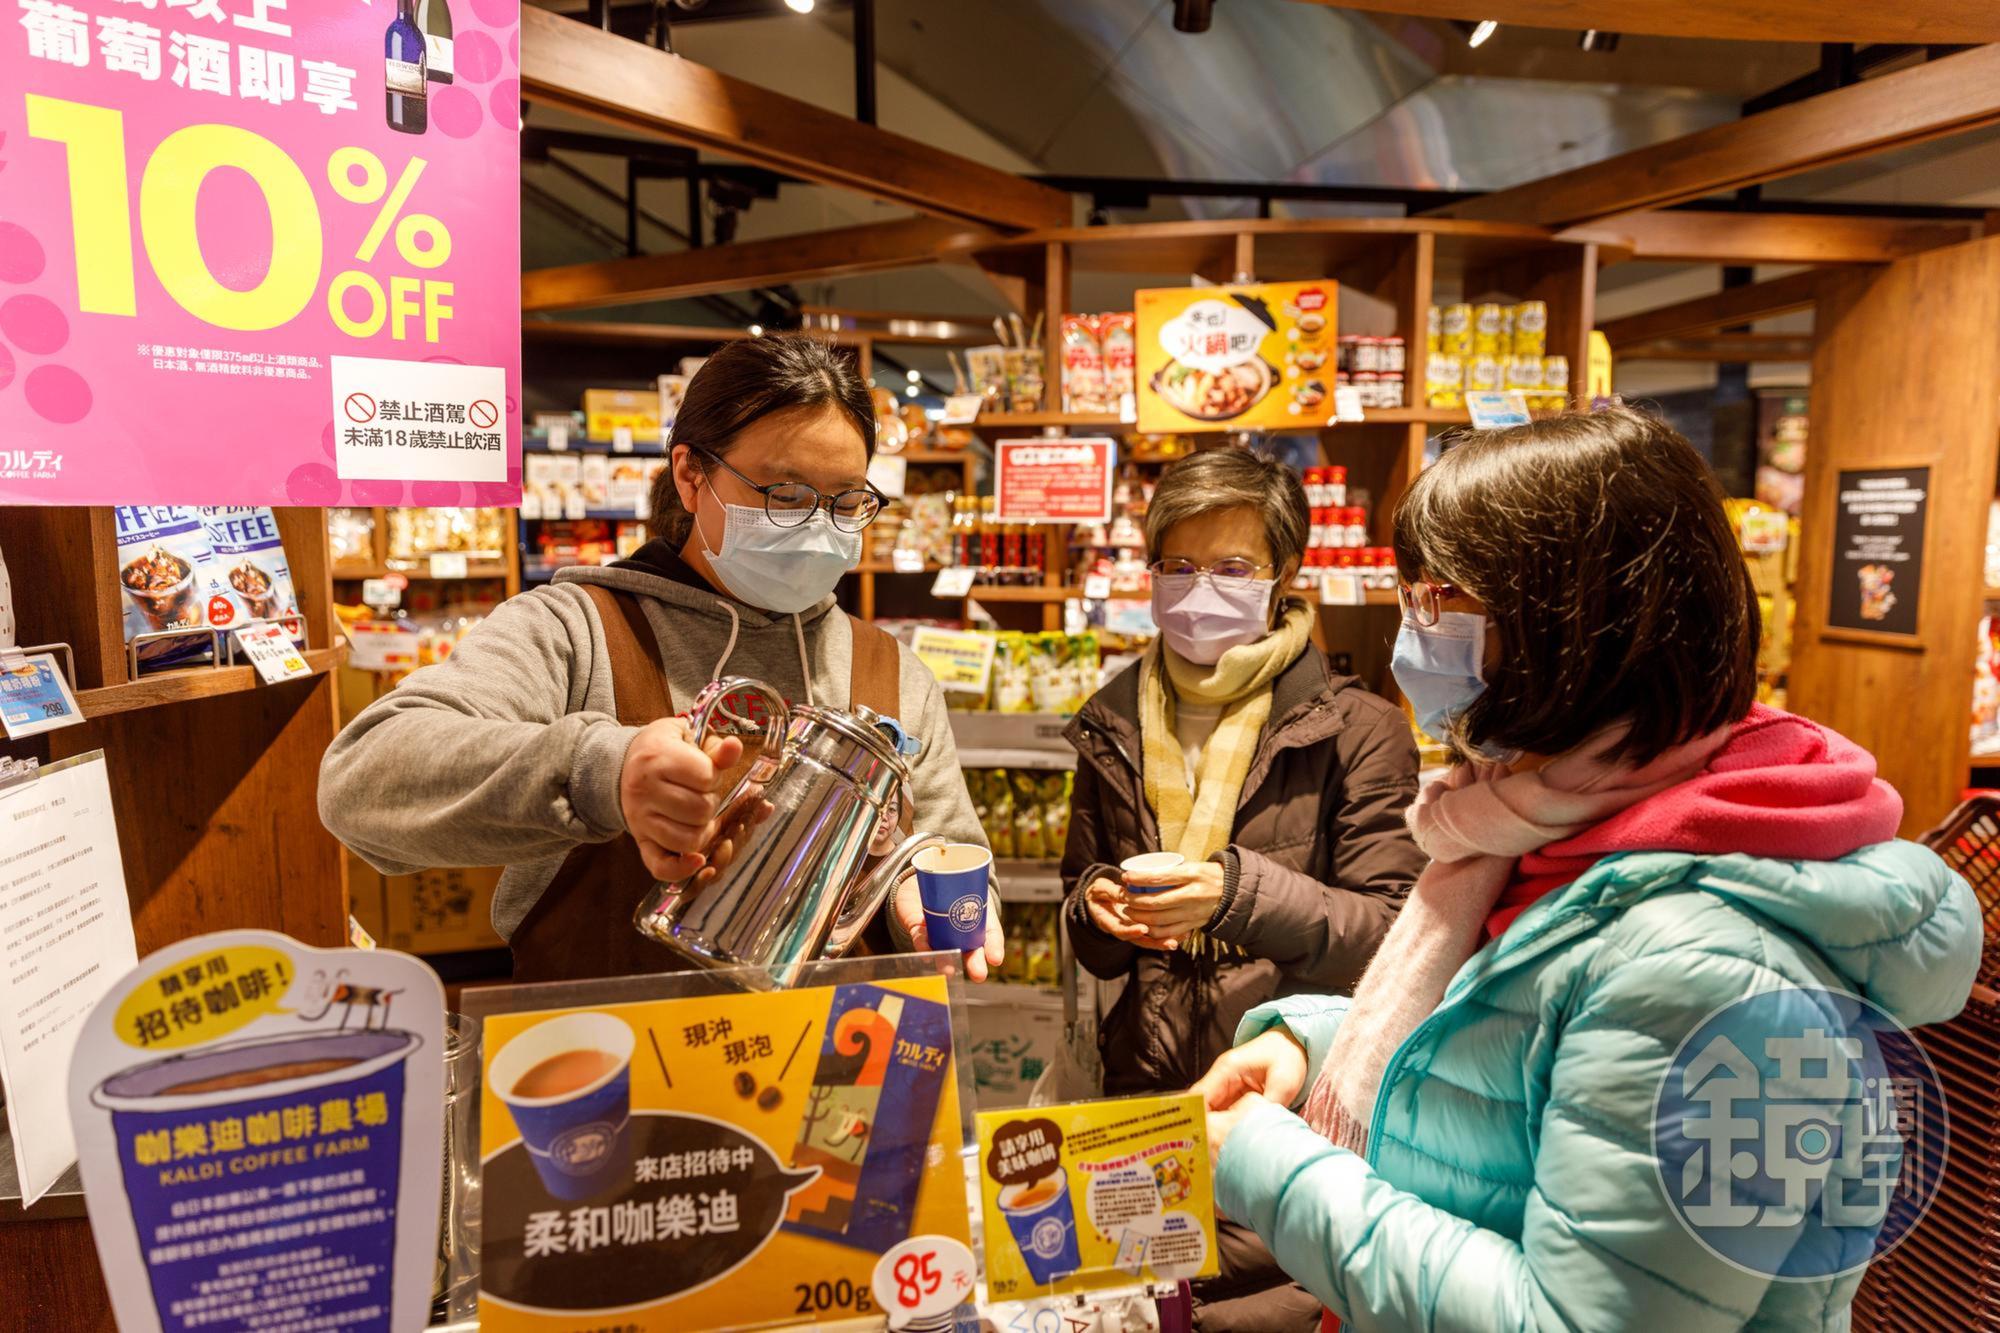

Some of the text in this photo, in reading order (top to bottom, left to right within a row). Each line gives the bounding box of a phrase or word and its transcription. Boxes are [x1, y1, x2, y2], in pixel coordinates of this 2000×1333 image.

[18, 0, 358, 115] 葡萄酒即享
[25, 93, 452, 331] 10%
[328, 270, 454, 343] OFF
[379, 399, 466, 425] 禁止酒駕
[344, 427, 502, 453] 未滿18歲禁止飲酒
[42, 702, 64, 718] 299
[159, 955, 230, 997] 請享用
[683, 1016, 733, 1049] 現沖
[723, 1033, 774, 1066] 現泡
[895, 1038, 945, 1067] カルディ
[134, 1092, 389, 1166] 咖樂迪咖啡農場
[160, 1135, 371, 1187] KALDI COFFEE FARM
[634, 1145, 754, 1184] 來店招待中
[523, 1189, 741, 1259] 柔和咖樂迪
[794, 1279, 872, 1313] 200g
[893, 1251, 943, 1309] 85
